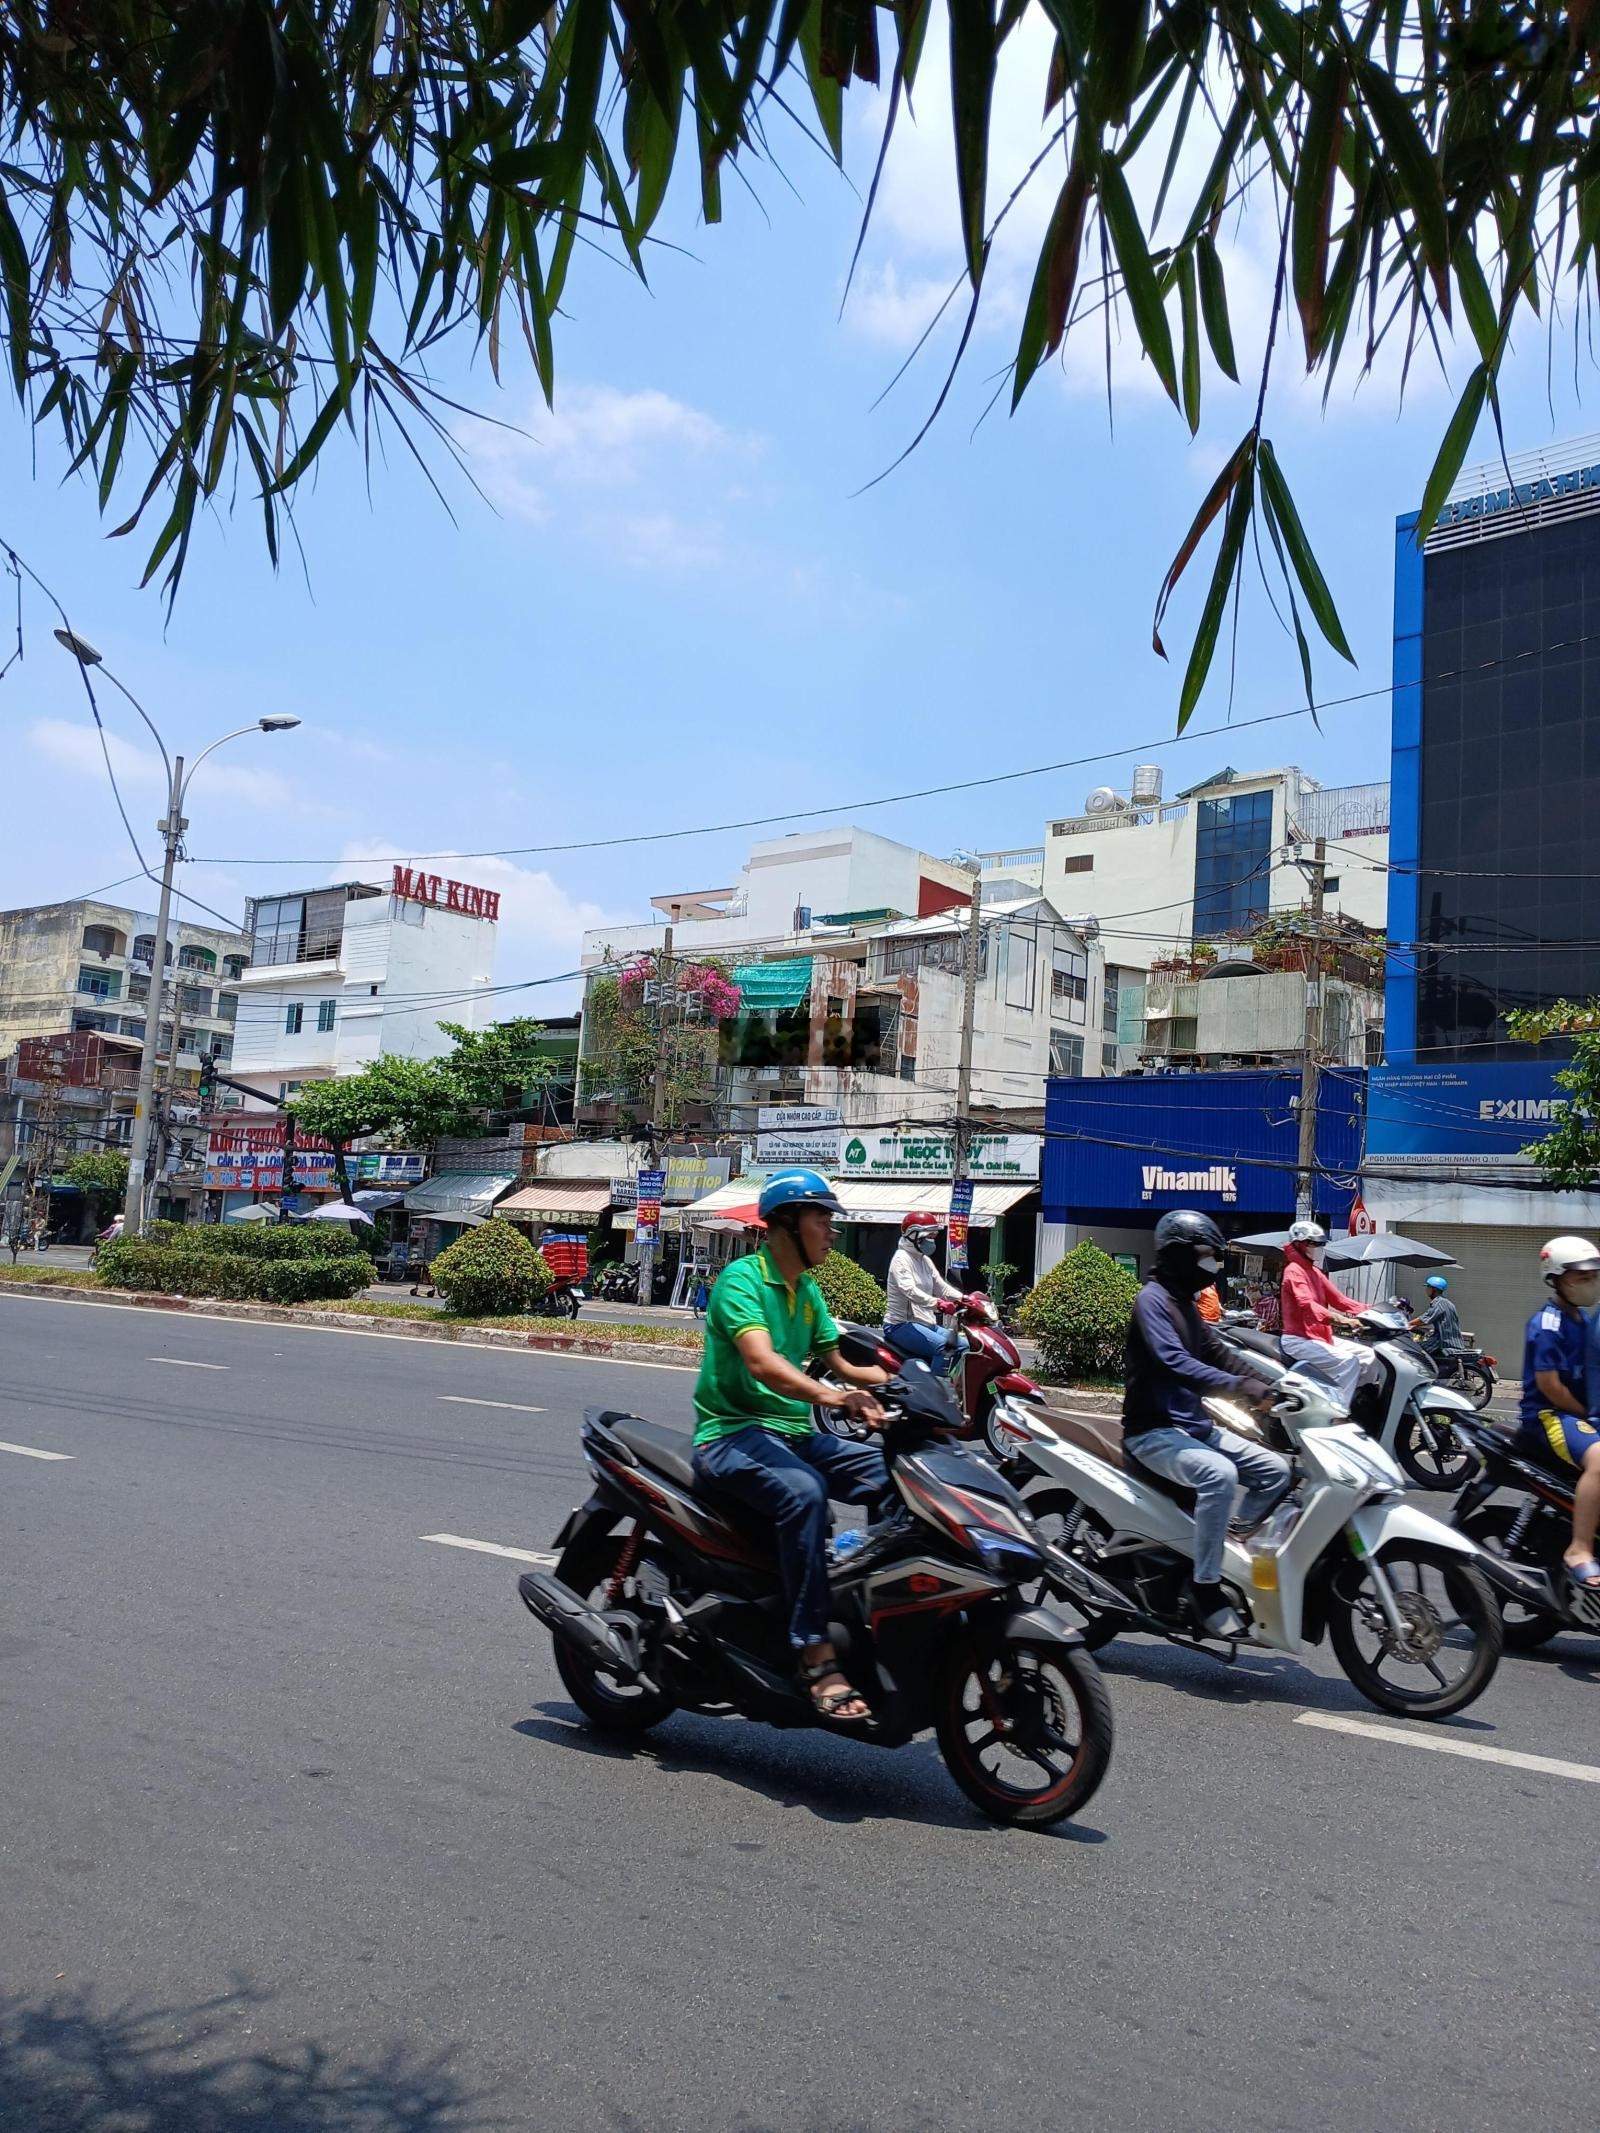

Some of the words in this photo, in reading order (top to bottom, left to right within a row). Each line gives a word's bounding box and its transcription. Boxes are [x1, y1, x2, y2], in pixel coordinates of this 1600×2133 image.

[1142, 1165, 1238, 1191] Vinamilk
[1142, 1191, 1153, 1201] EST
[1222, 1192, 1237, 1202] 1976
